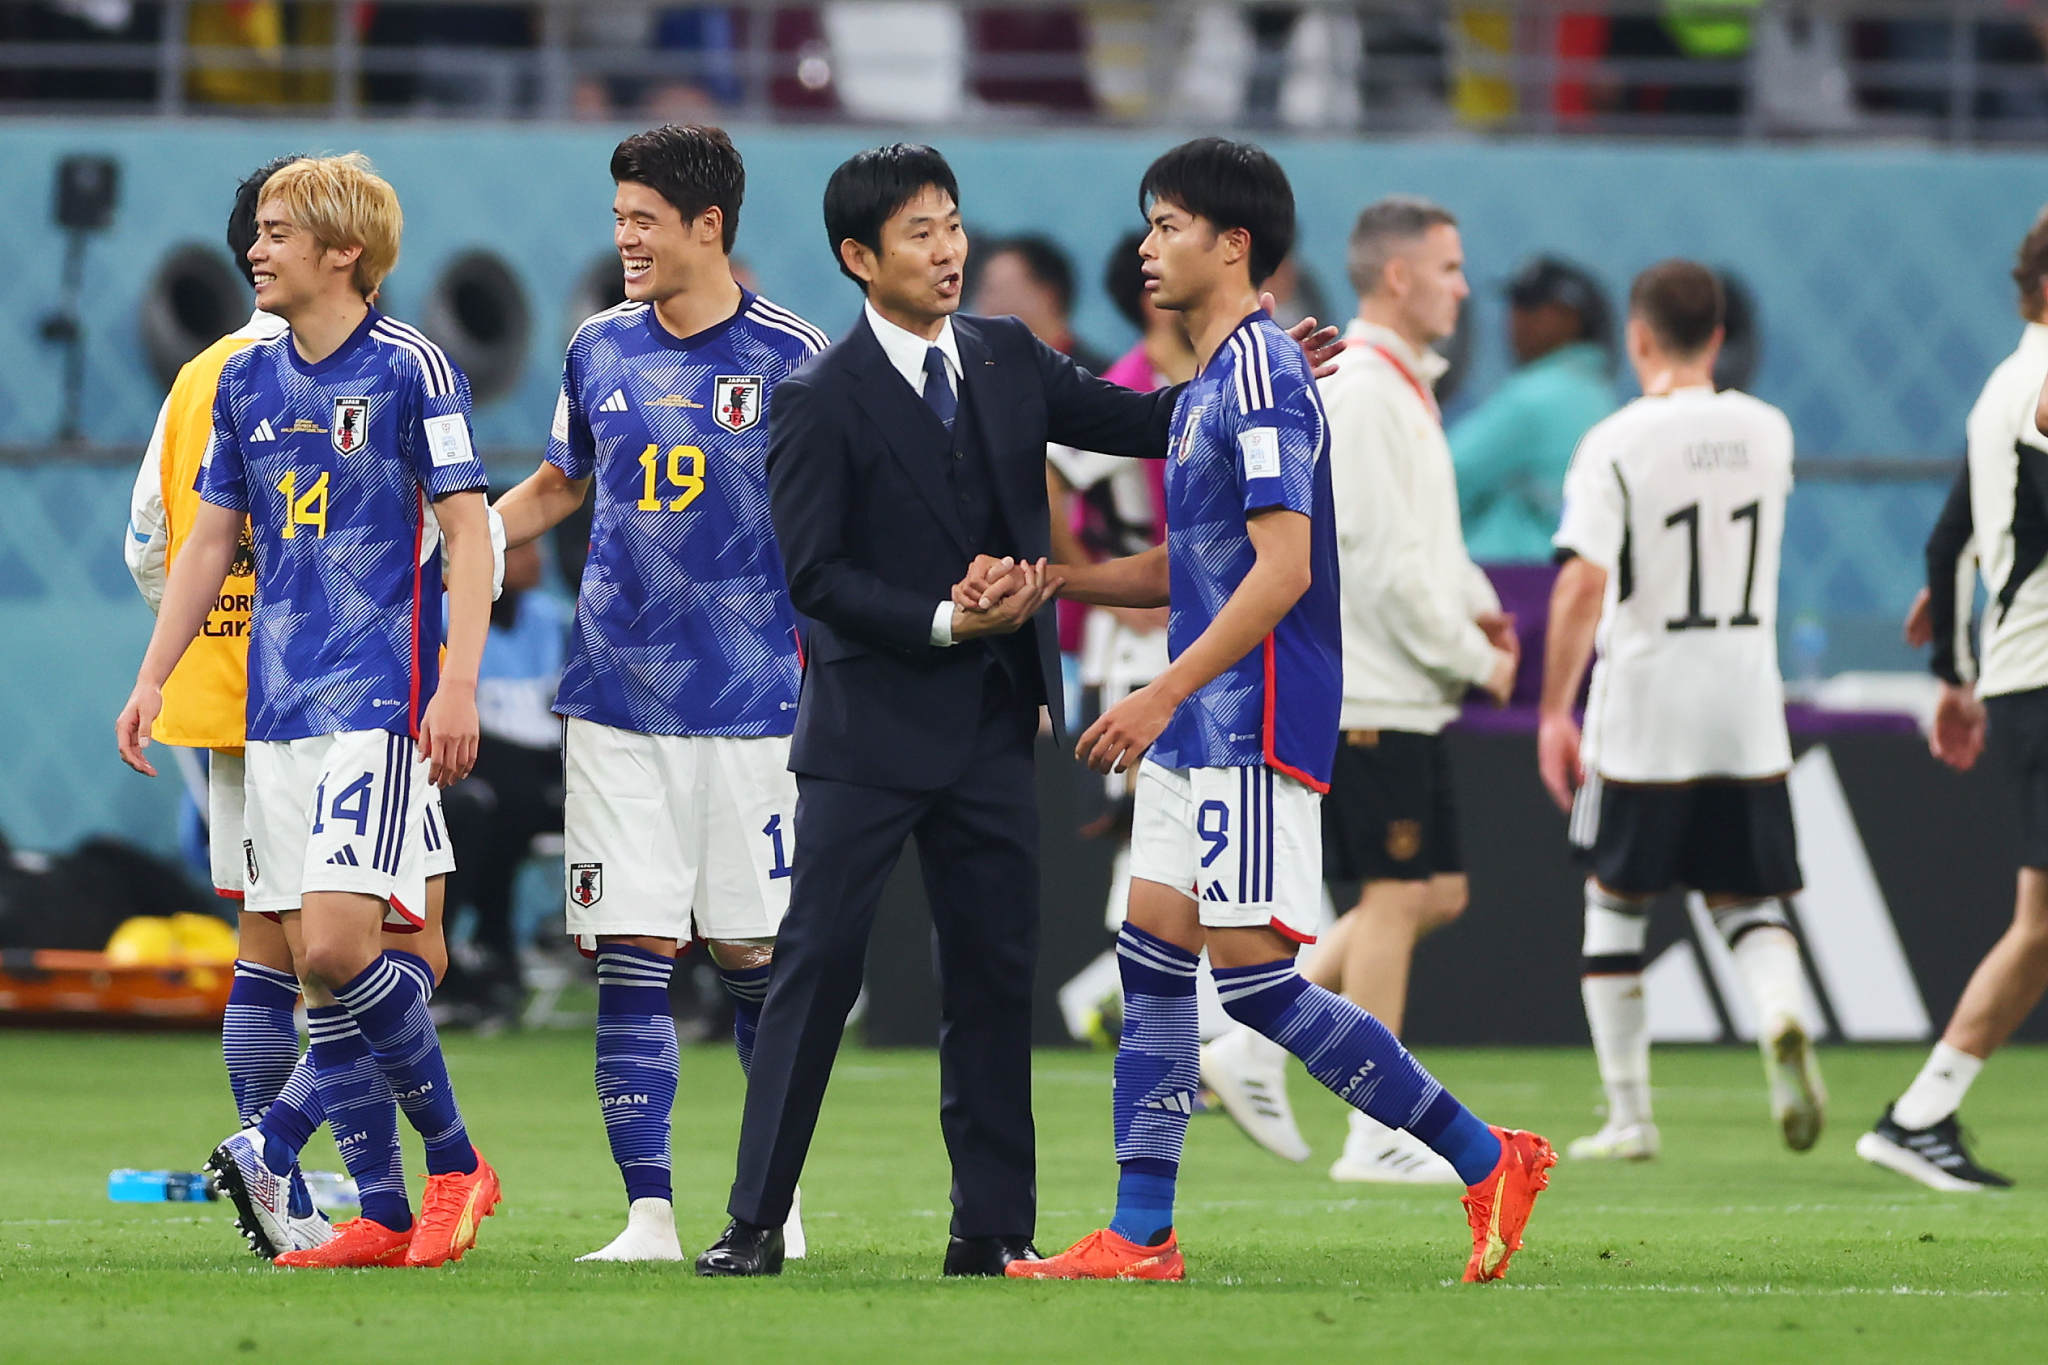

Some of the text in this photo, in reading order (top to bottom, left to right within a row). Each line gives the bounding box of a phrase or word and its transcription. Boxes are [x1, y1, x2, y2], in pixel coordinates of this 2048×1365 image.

[276, 471, 331, 539] 14
[638, 444, 706, 512] 19
[1665, 501, 1760, 631] 11
[213, 595, 254, 611] OR
[312, 771, 374, 836] 14
[1197, 800, 1229, 868] 9
